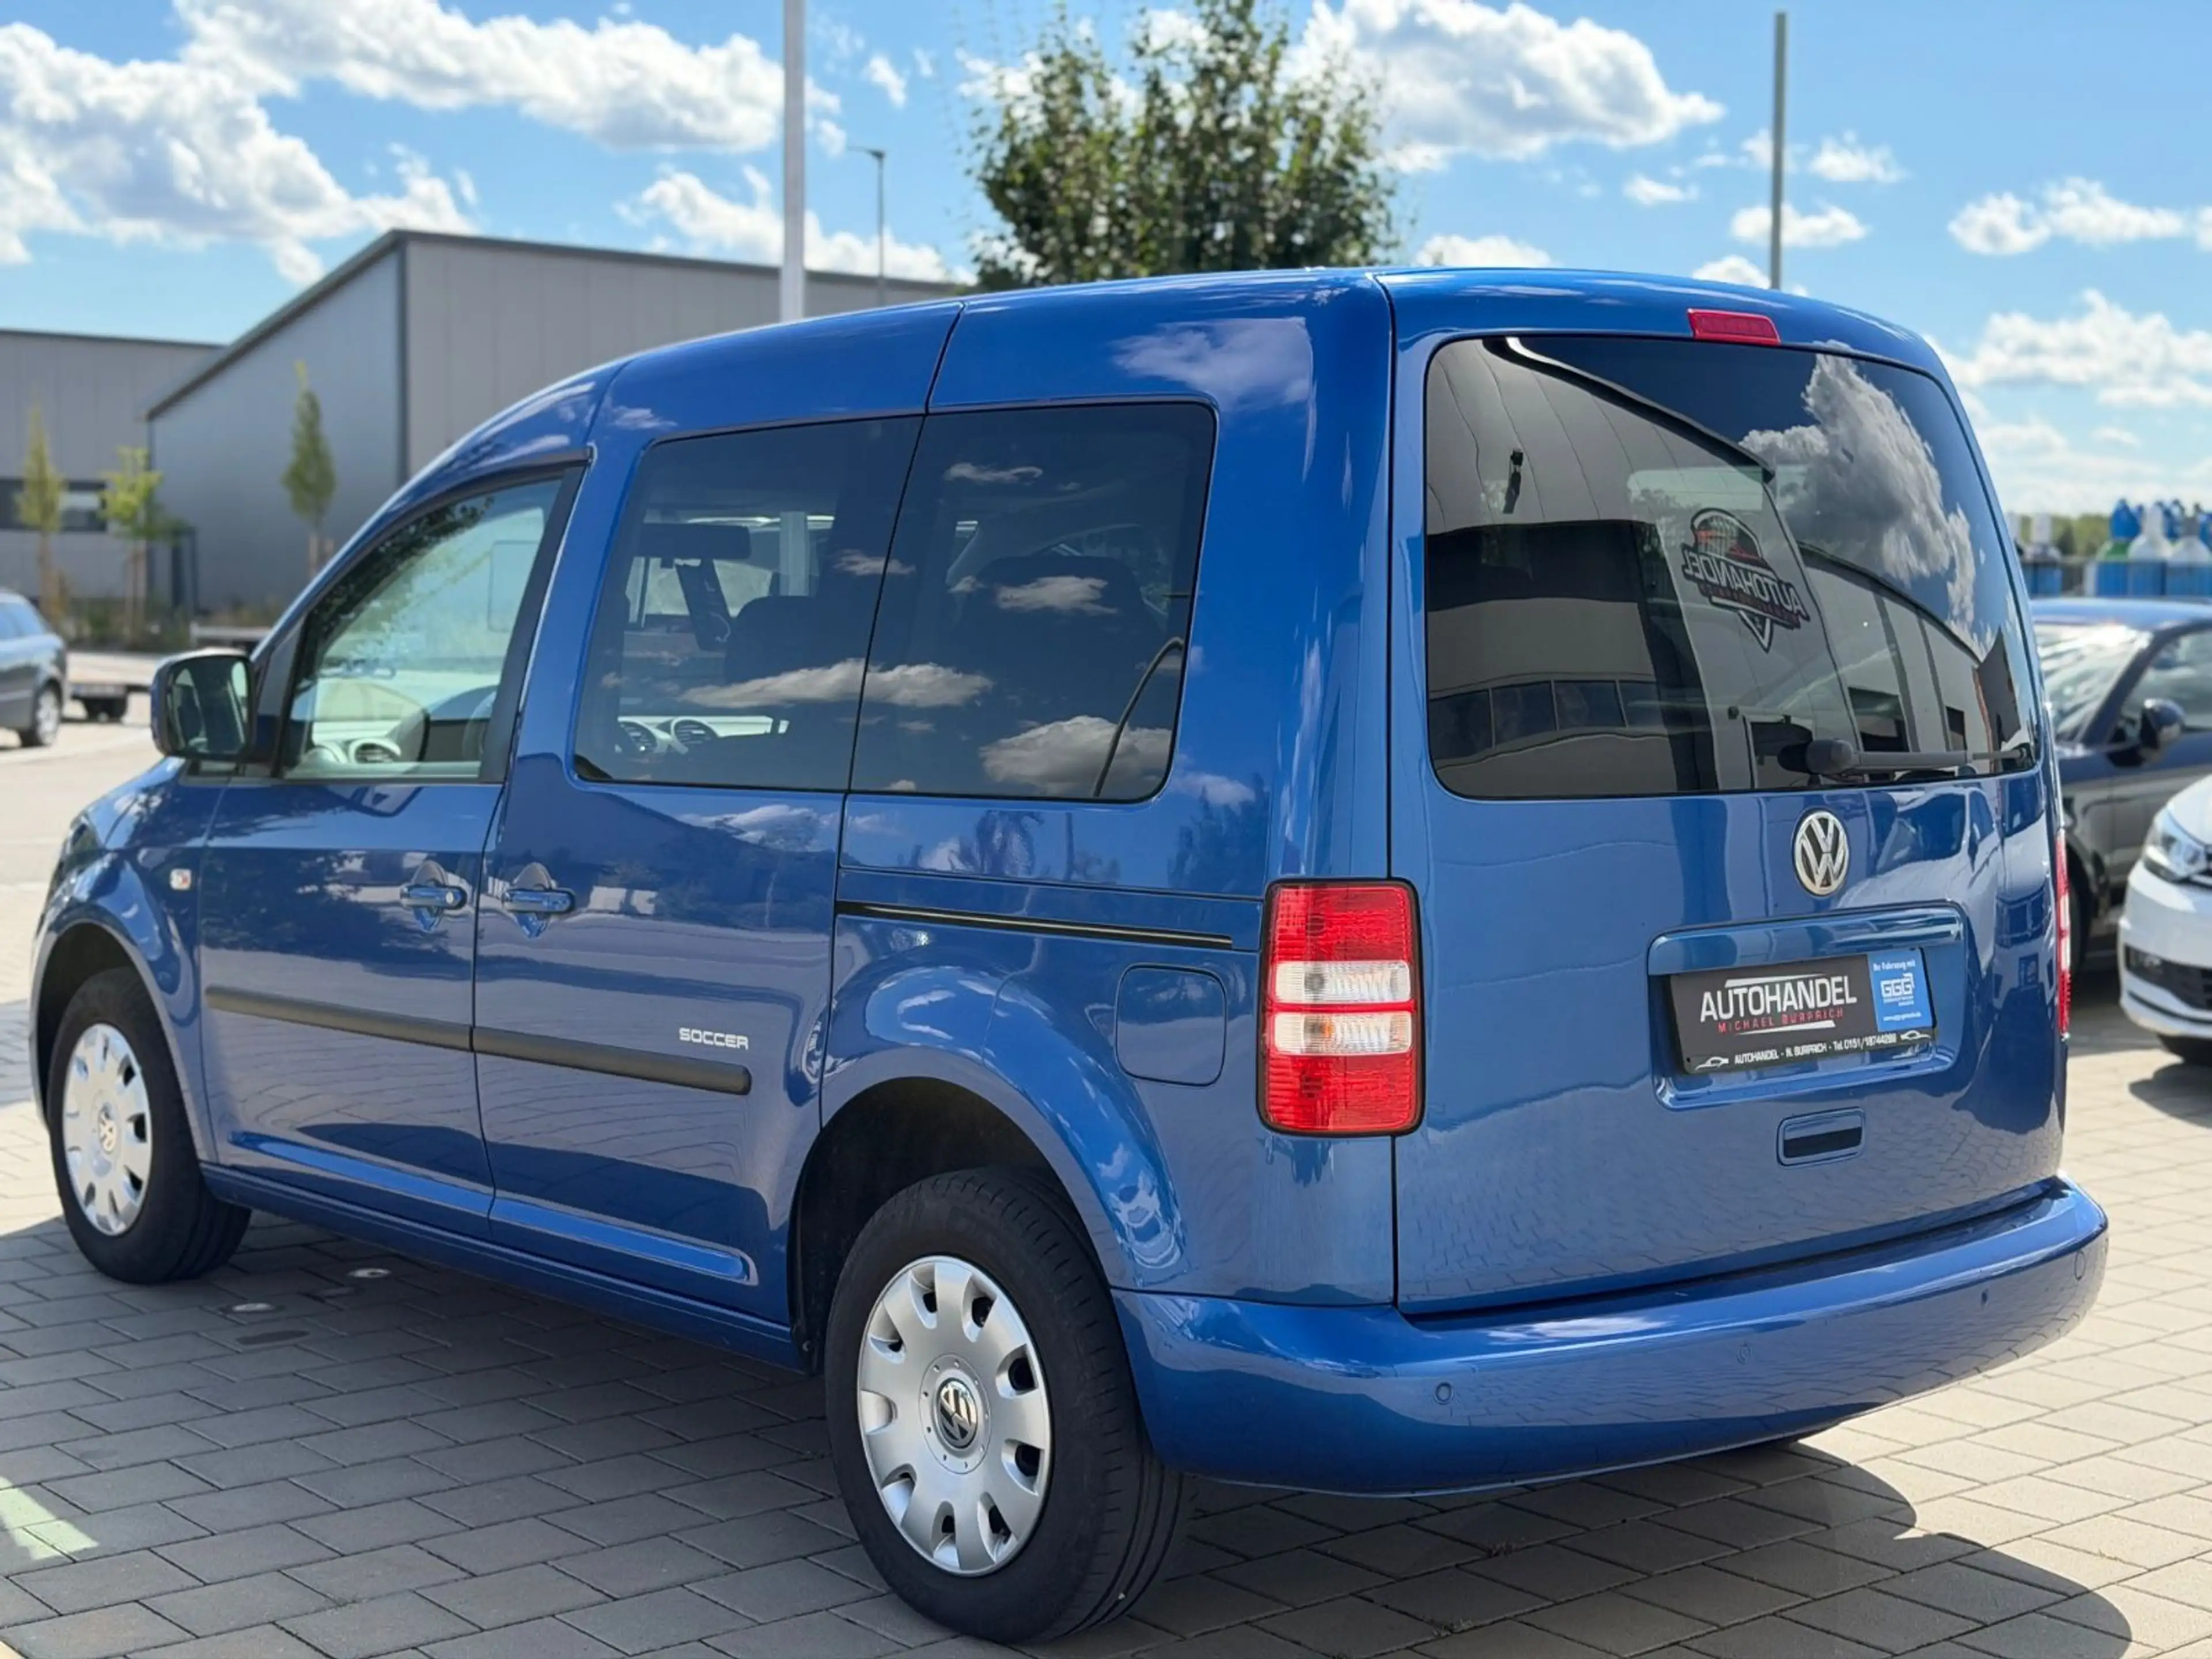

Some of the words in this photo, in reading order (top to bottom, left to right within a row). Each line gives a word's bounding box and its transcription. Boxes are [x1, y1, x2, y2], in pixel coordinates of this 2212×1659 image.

[1700, 975, 1857, 1022] AUTOHANDEL
[1718, 1016, 1775, 1034] MICHAEL
[679, 1027, 749, 1051] SOCCER
[1734, 1048, 1780, 1065] AUTOHANDEL
